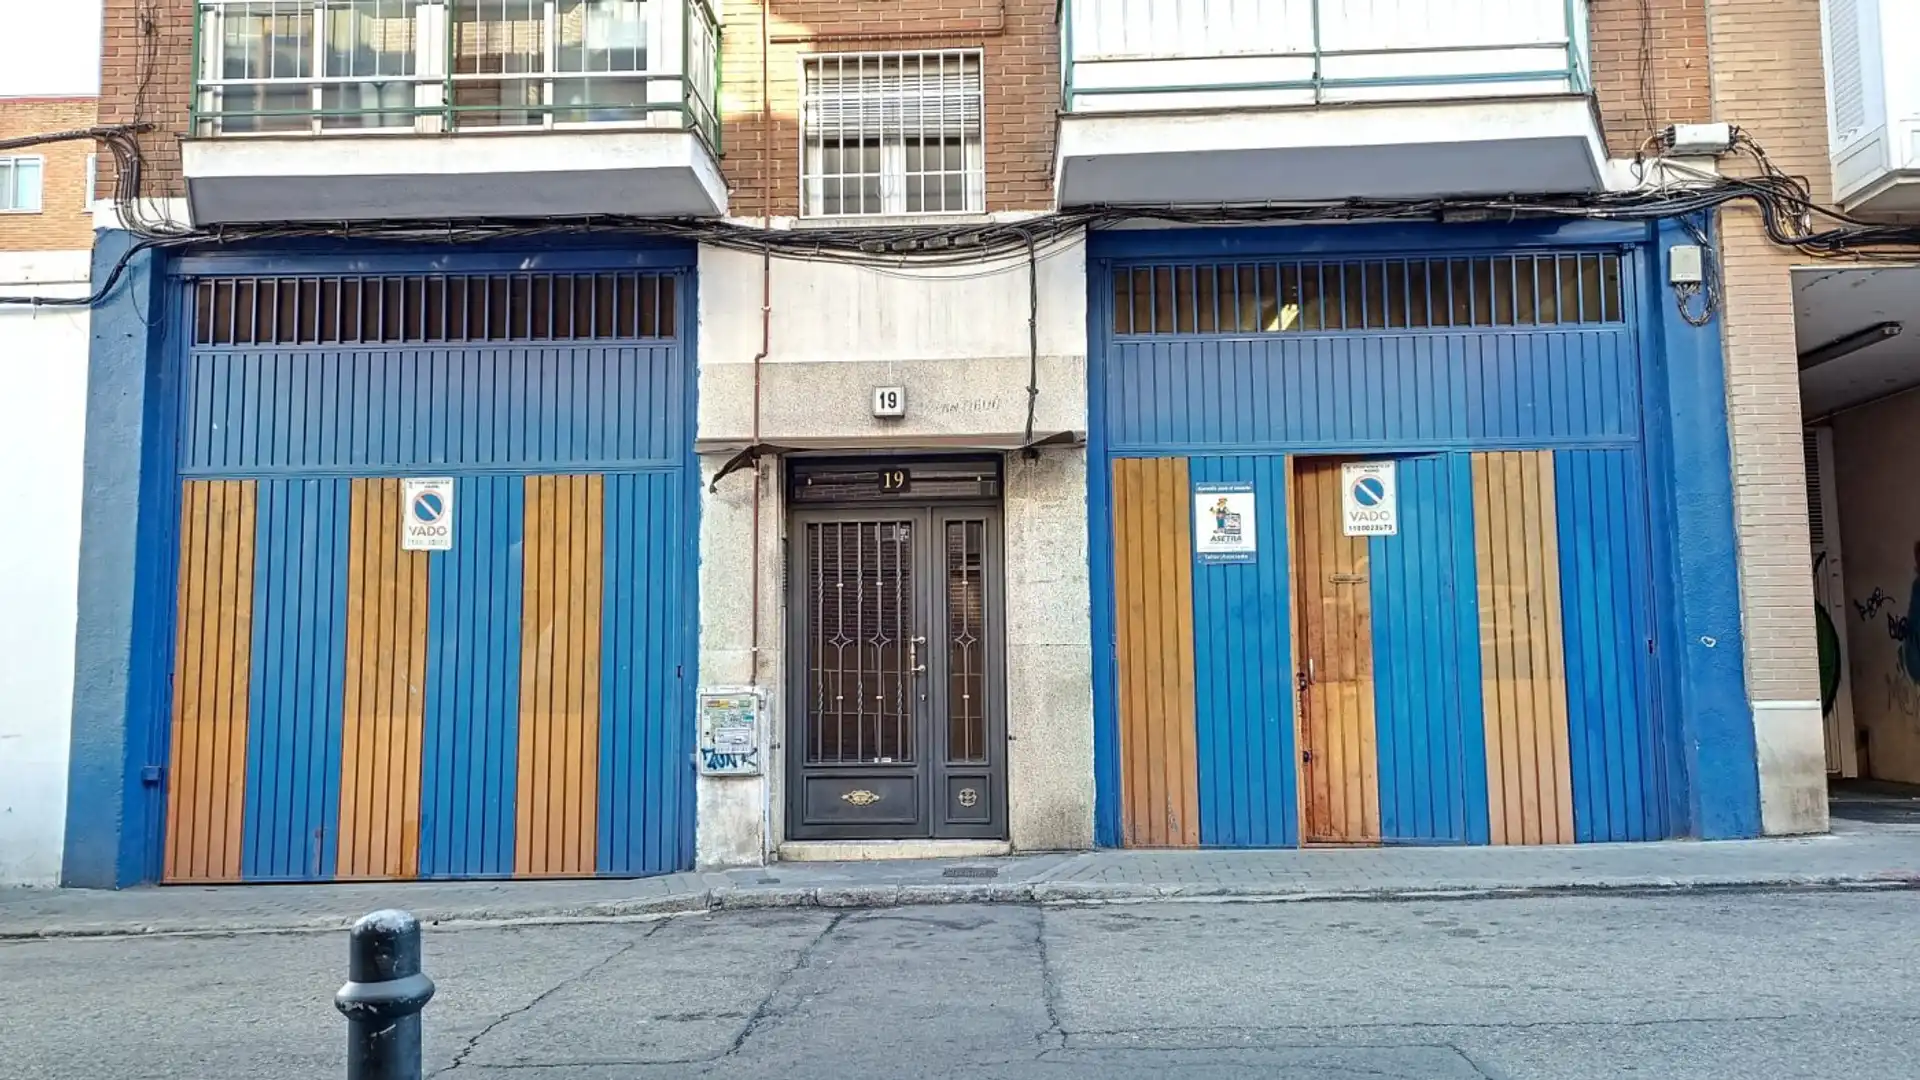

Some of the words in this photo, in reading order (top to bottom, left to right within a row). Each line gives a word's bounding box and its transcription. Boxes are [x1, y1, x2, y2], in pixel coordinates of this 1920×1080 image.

[880, 391, 897, 409] 19
[883, 470, 904, 489] 19
[1349, 511, 1391, 522] VADO
[409, 526, 448, 536] VADO
